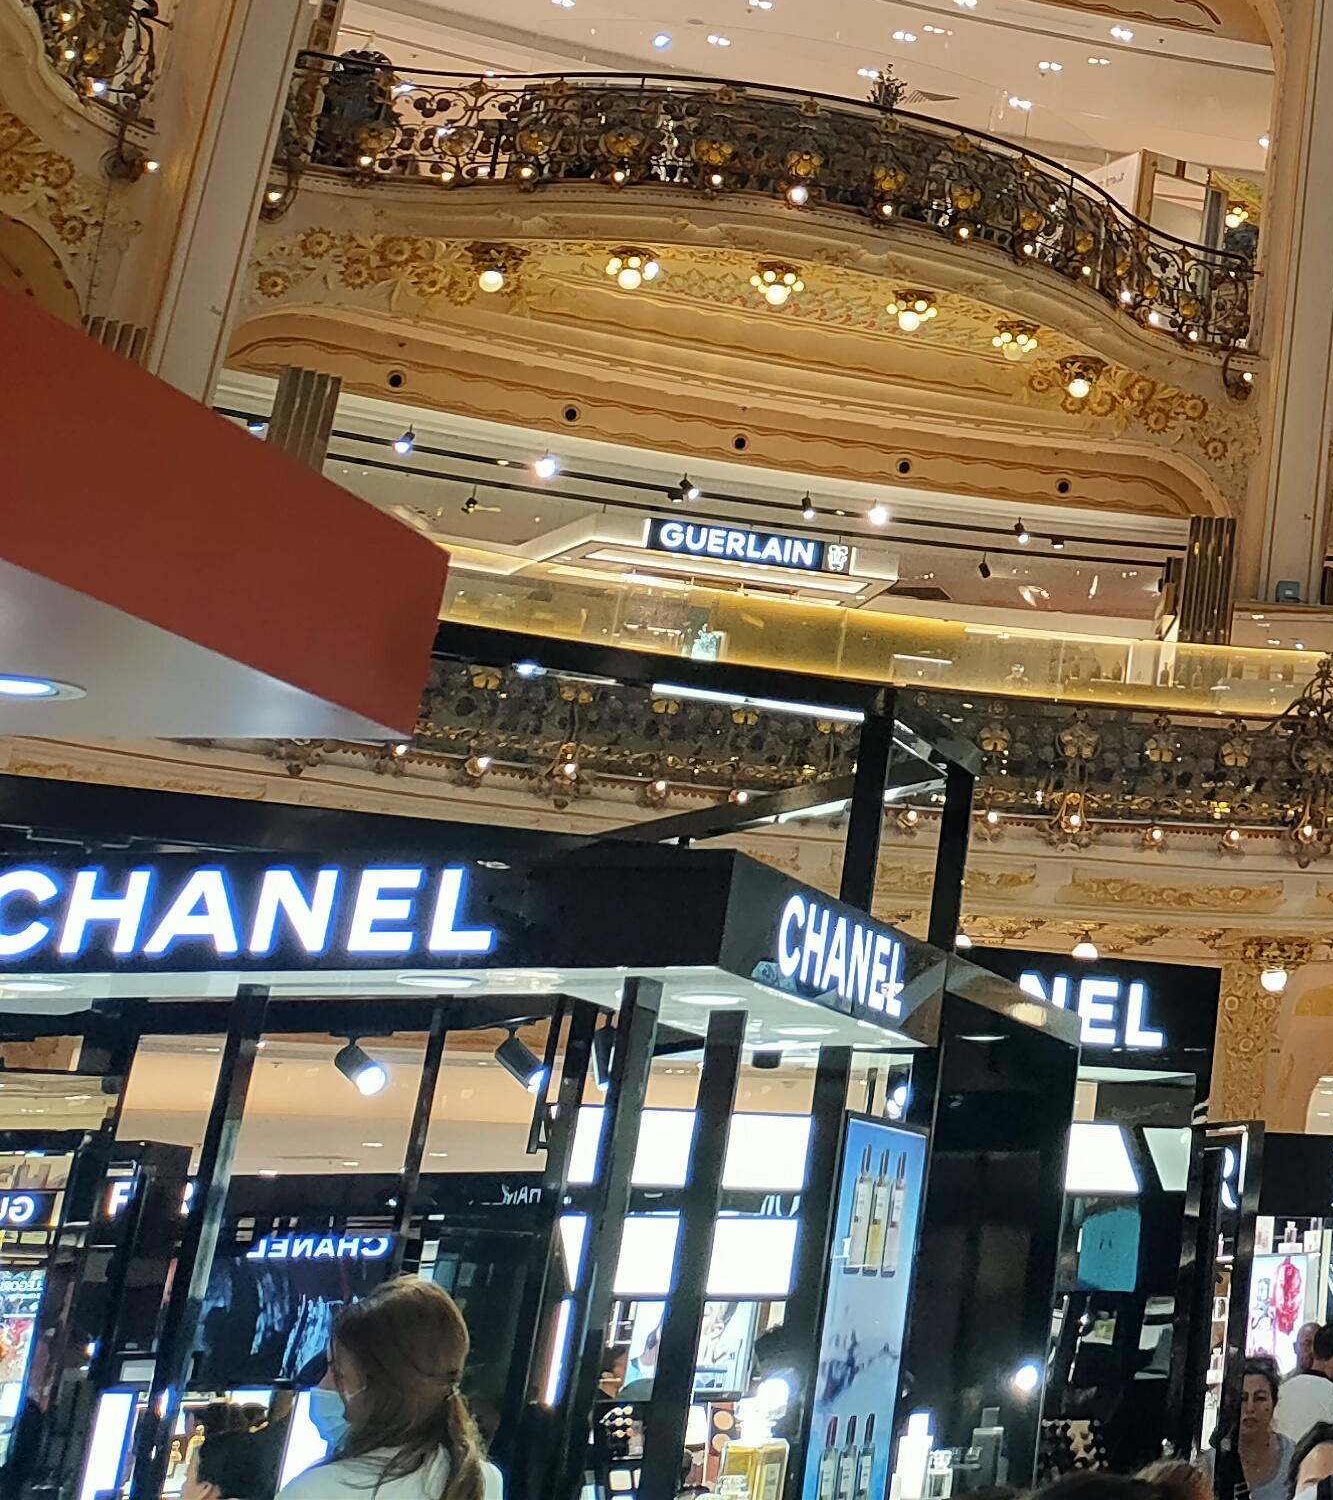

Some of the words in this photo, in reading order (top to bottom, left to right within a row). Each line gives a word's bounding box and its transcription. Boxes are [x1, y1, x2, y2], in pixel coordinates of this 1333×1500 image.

[660, 521, 816, 567] GUERLAIN
[0, 863, 497, 956] CHANEL
[778, 895, 905, 1020] CHANEL
[1019, 972, 1166, 1048] NEL
